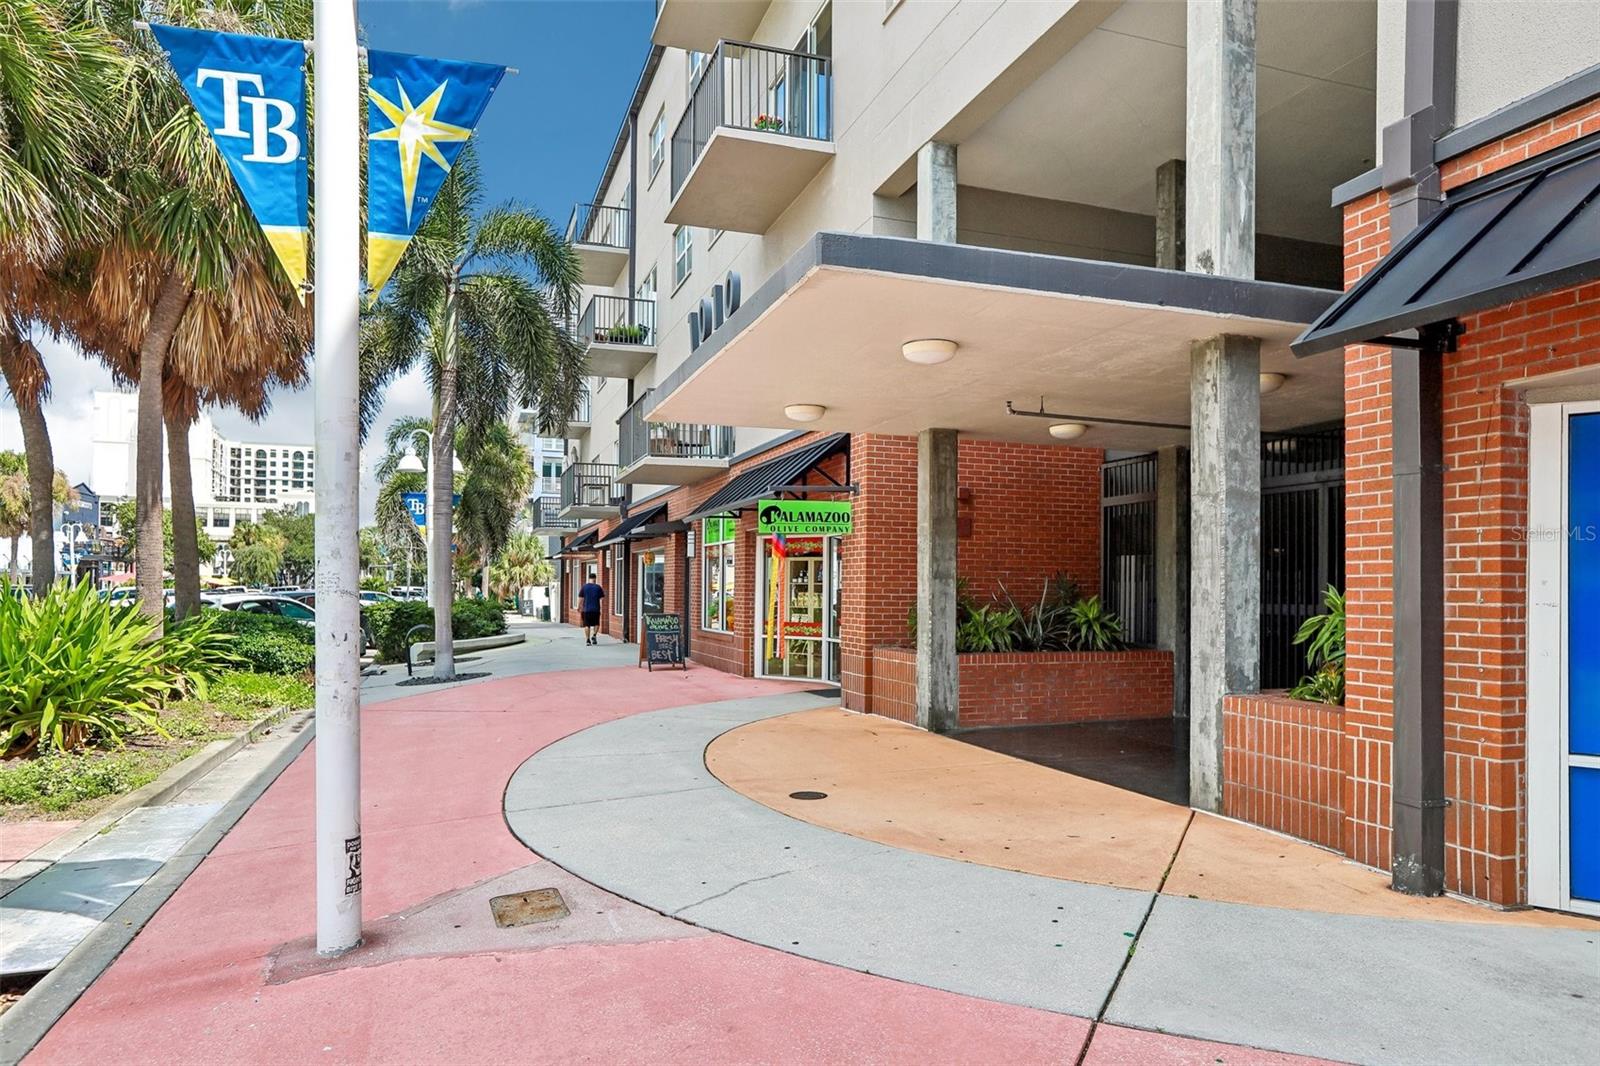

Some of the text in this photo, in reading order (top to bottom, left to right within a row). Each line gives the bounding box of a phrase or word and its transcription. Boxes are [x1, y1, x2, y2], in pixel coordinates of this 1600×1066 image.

[196, 68, 301, 164] TB
[416, 196, 429, 204] TM
[407, 498, 425, 515] TB
[770, 510, 851, 523] KALAMAZOO
[770, 525, 850, 533] OLIVE COMPANY
